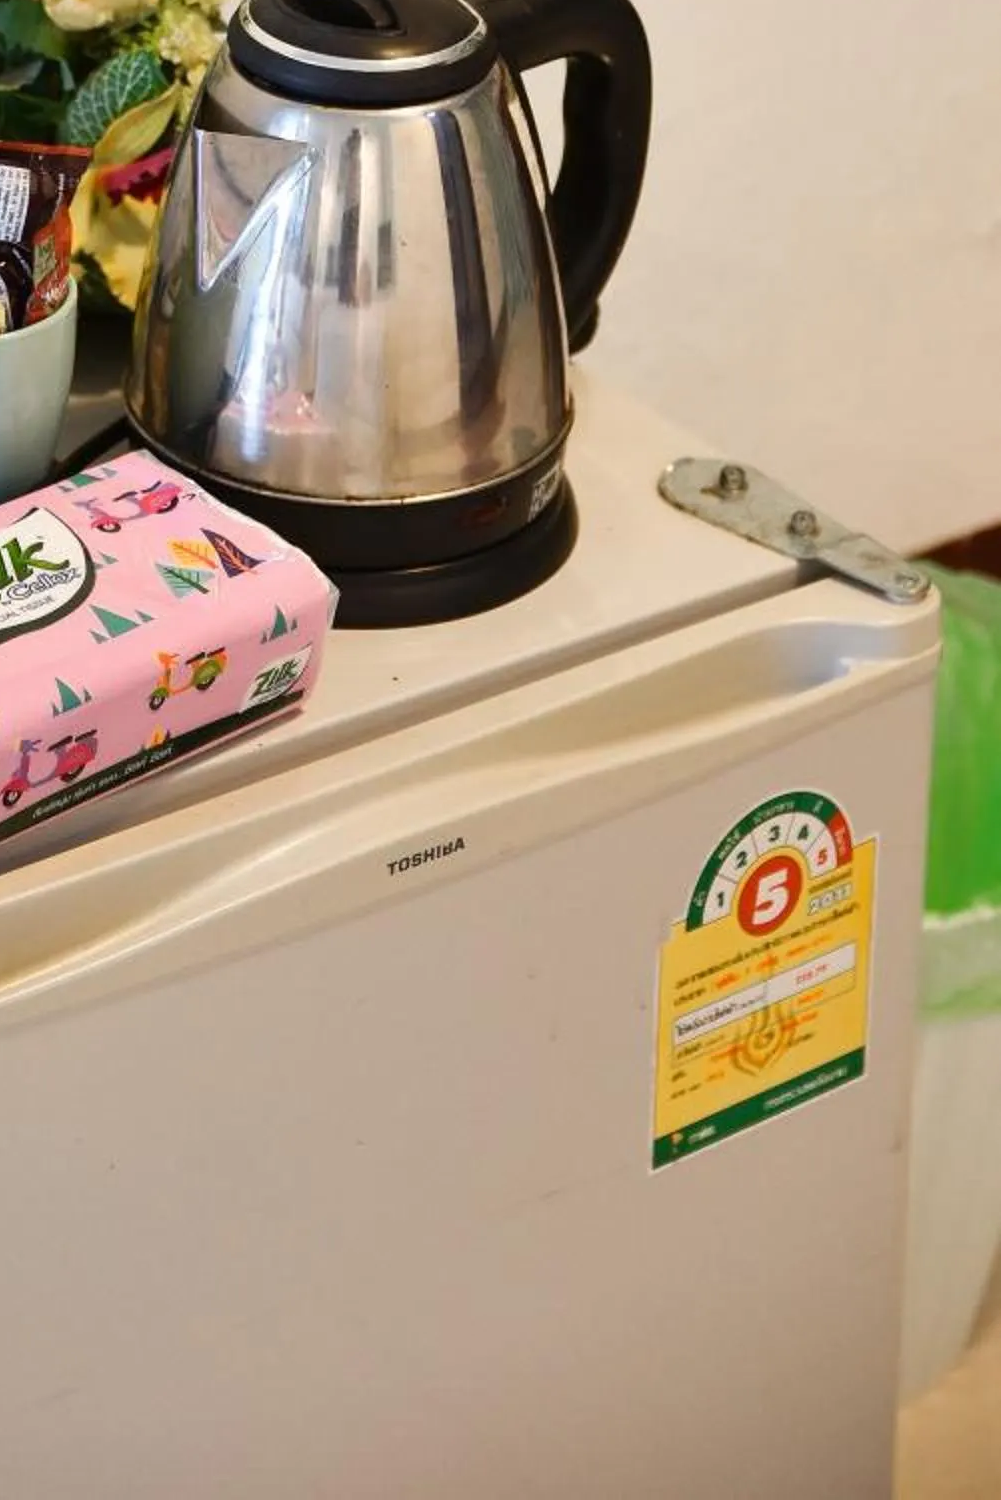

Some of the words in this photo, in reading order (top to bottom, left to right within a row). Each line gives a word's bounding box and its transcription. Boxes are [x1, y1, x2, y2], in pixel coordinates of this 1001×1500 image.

[386, 837, 466, 876] TOSHIBA
[716, 891, 725, 908] 1
[736, 850, 748, 869] 2
[768, 825, 781, 842] 3
[797, 825, 809, 840] 4
[817, 849, 828, 867] 5
[751, 867, 790, 926] 5
